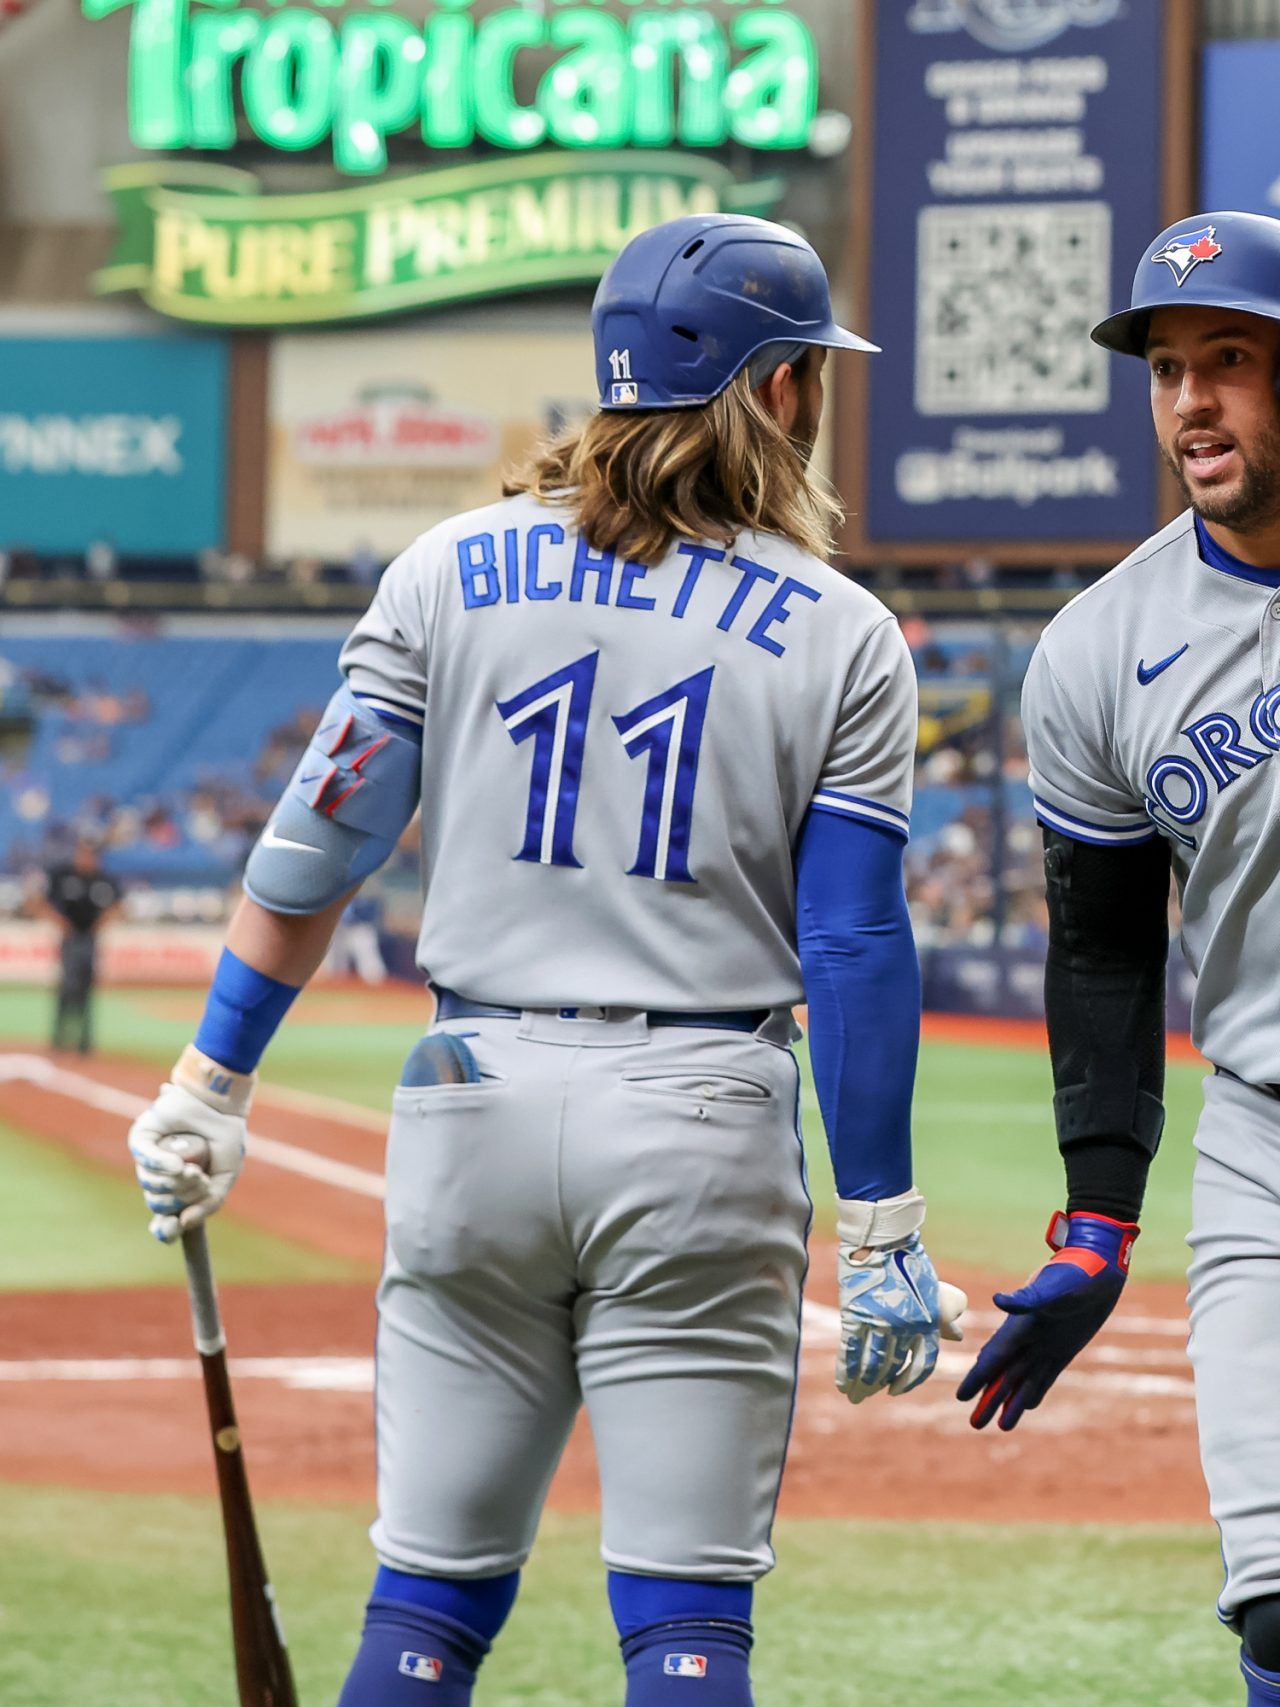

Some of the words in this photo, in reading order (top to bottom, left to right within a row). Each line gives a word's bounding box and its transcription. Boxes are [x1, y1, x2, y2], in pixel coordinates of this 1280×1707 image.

[83, 0, 820, 173] Tropicana
[150, 208, 356, 298] PURE
[363, 174, 720, 289] PREMIUM
[608, 348, 632, 379] 11
[457, 523, 822, 658] BICHETTE
[494, 649, 716, 883] 11
